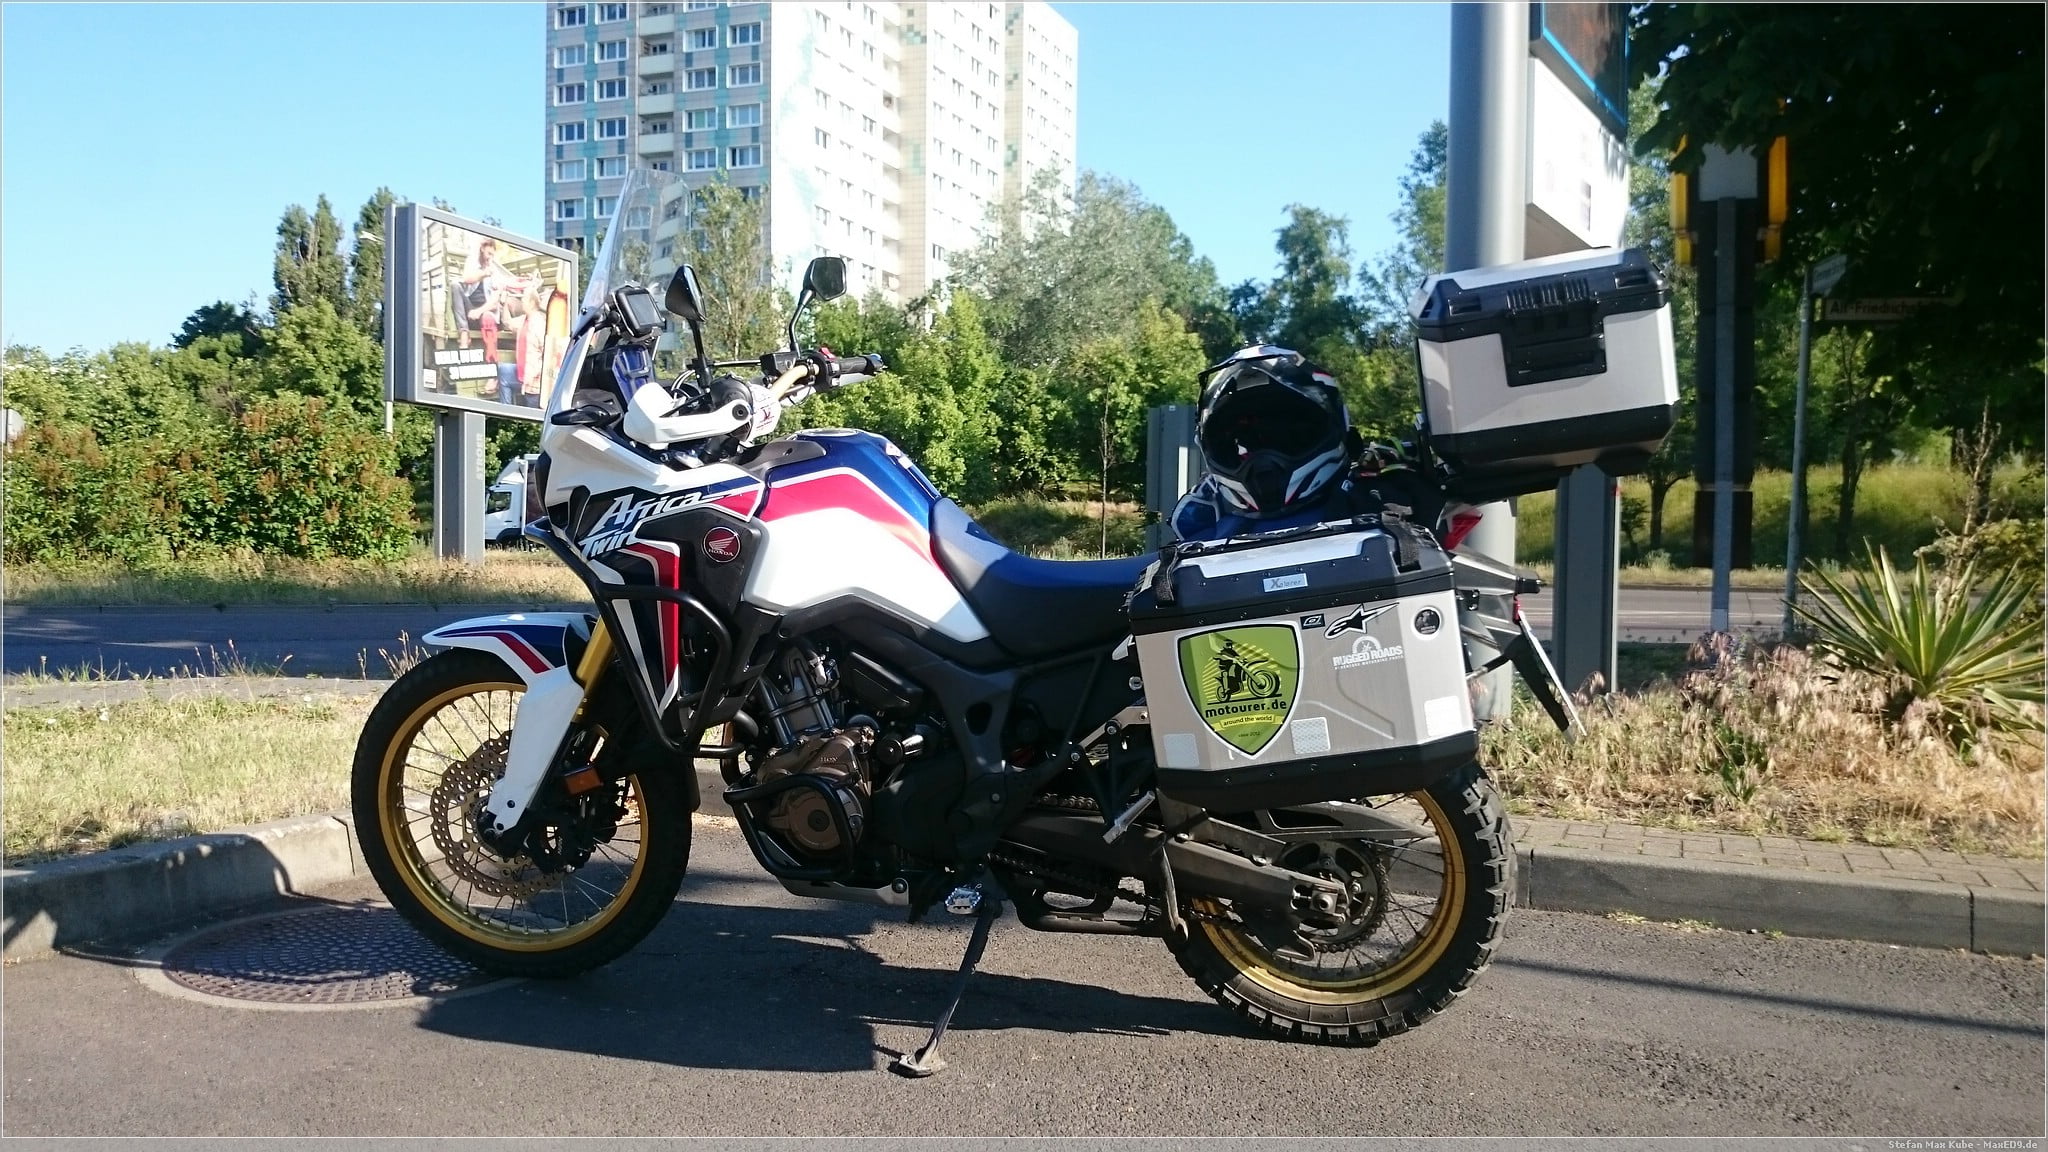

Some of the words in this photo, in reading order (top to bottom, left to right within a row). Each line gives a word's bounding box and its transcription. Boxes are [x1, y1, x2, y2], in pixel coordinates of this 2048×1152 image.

[587, 491, 706, 535] Africa
[578, 529, 640, 560] Twin
[708, 548, 734, 557] HONDA
[1332, 651, 1370, 667] RUGGED
[1370, 645, 1403, 660] ROADS
[1205, 699, 1287, 718] motourer.de
[1223, 717, 1244, 726] around
